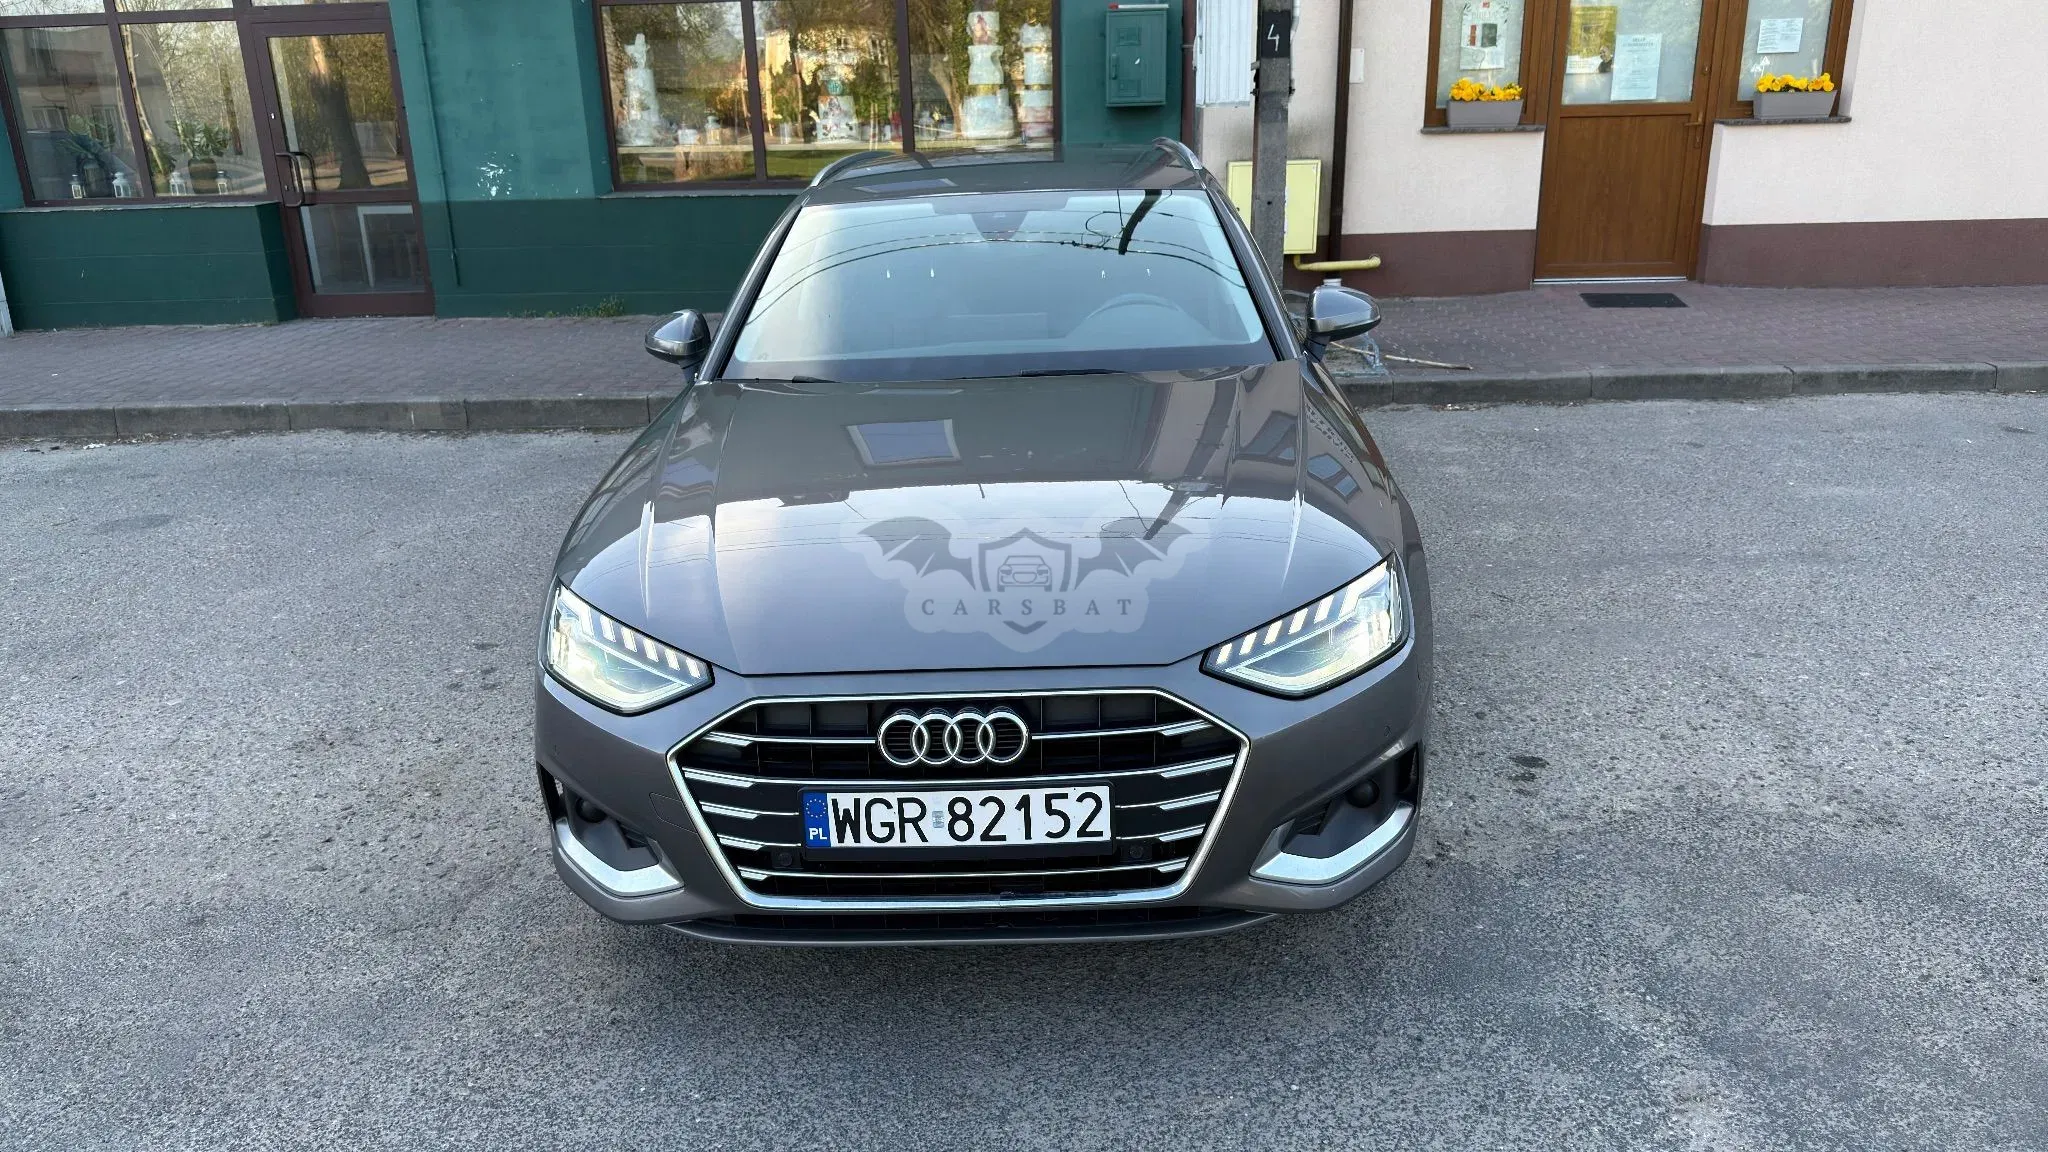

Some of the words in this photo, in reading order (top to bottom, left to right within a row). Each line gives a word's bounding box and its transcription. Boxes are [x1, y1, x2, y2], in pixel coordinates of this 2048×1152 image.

[1267, 23, 1281, 51] 4
[831, 797, 928, 843] WGR
[947, 792, 1104, 842] 82152
[809, 828, 827, 840] PL
